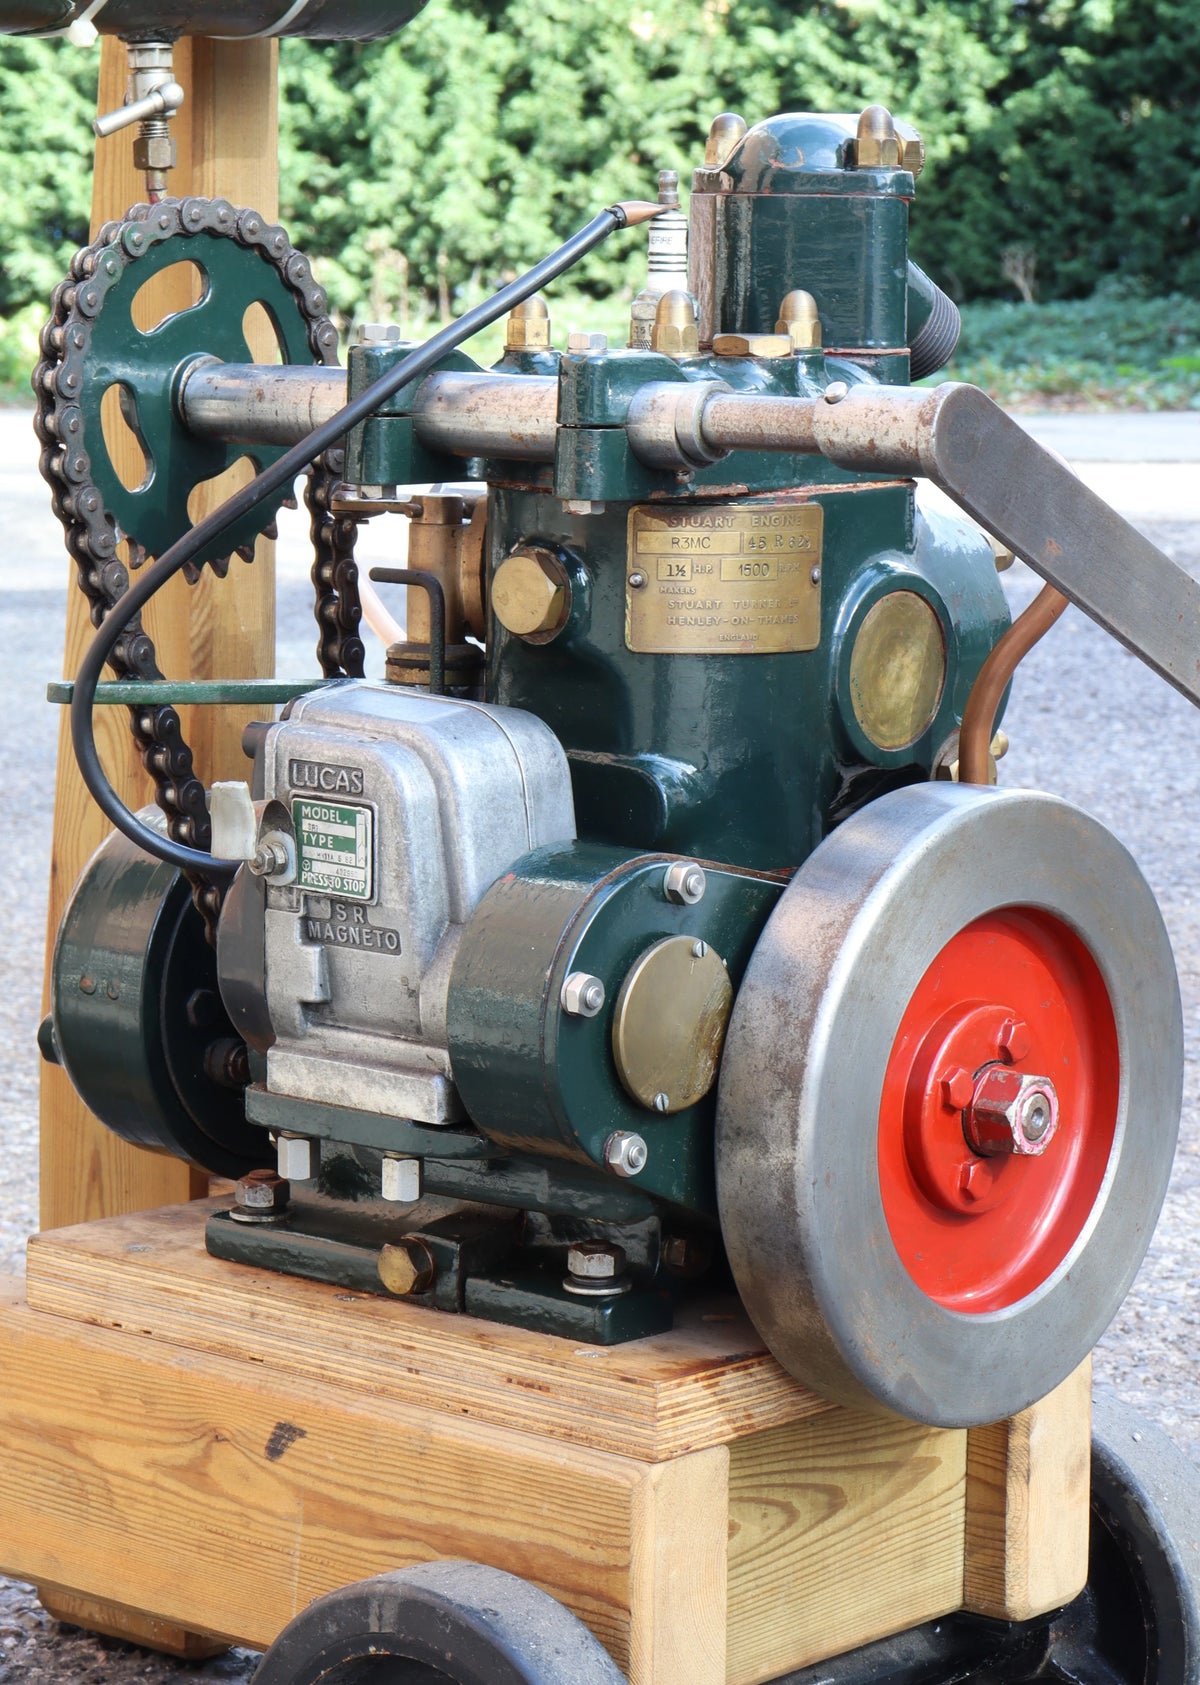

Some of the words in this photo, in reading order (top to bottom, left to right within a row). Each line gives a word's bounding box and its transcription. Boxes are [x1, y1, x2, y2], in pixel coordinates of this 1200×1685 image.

[670, 515, 737, 529] STUART
[751, 514, 801, 528] ENGINE
[671, 536, 712, 550] R3MC
[738, 562, 770, 577] 1500
[659, 586, 697, 595] MAKERS
[667, 600, 722, 610] STUART
[732, 599, 782, 609] TURNER
[719, 632, 759, 642] ENGLAND
[292, 762, 363, 794] LUCAS
[301, 805, 342, 823] MODEL
[302, 832, 334, 849] TYPE
[302, 871, 329, 887] PRESS
[343, 878, 366, 893] STOP
[308, 919, 398, 950] MAGNETO
